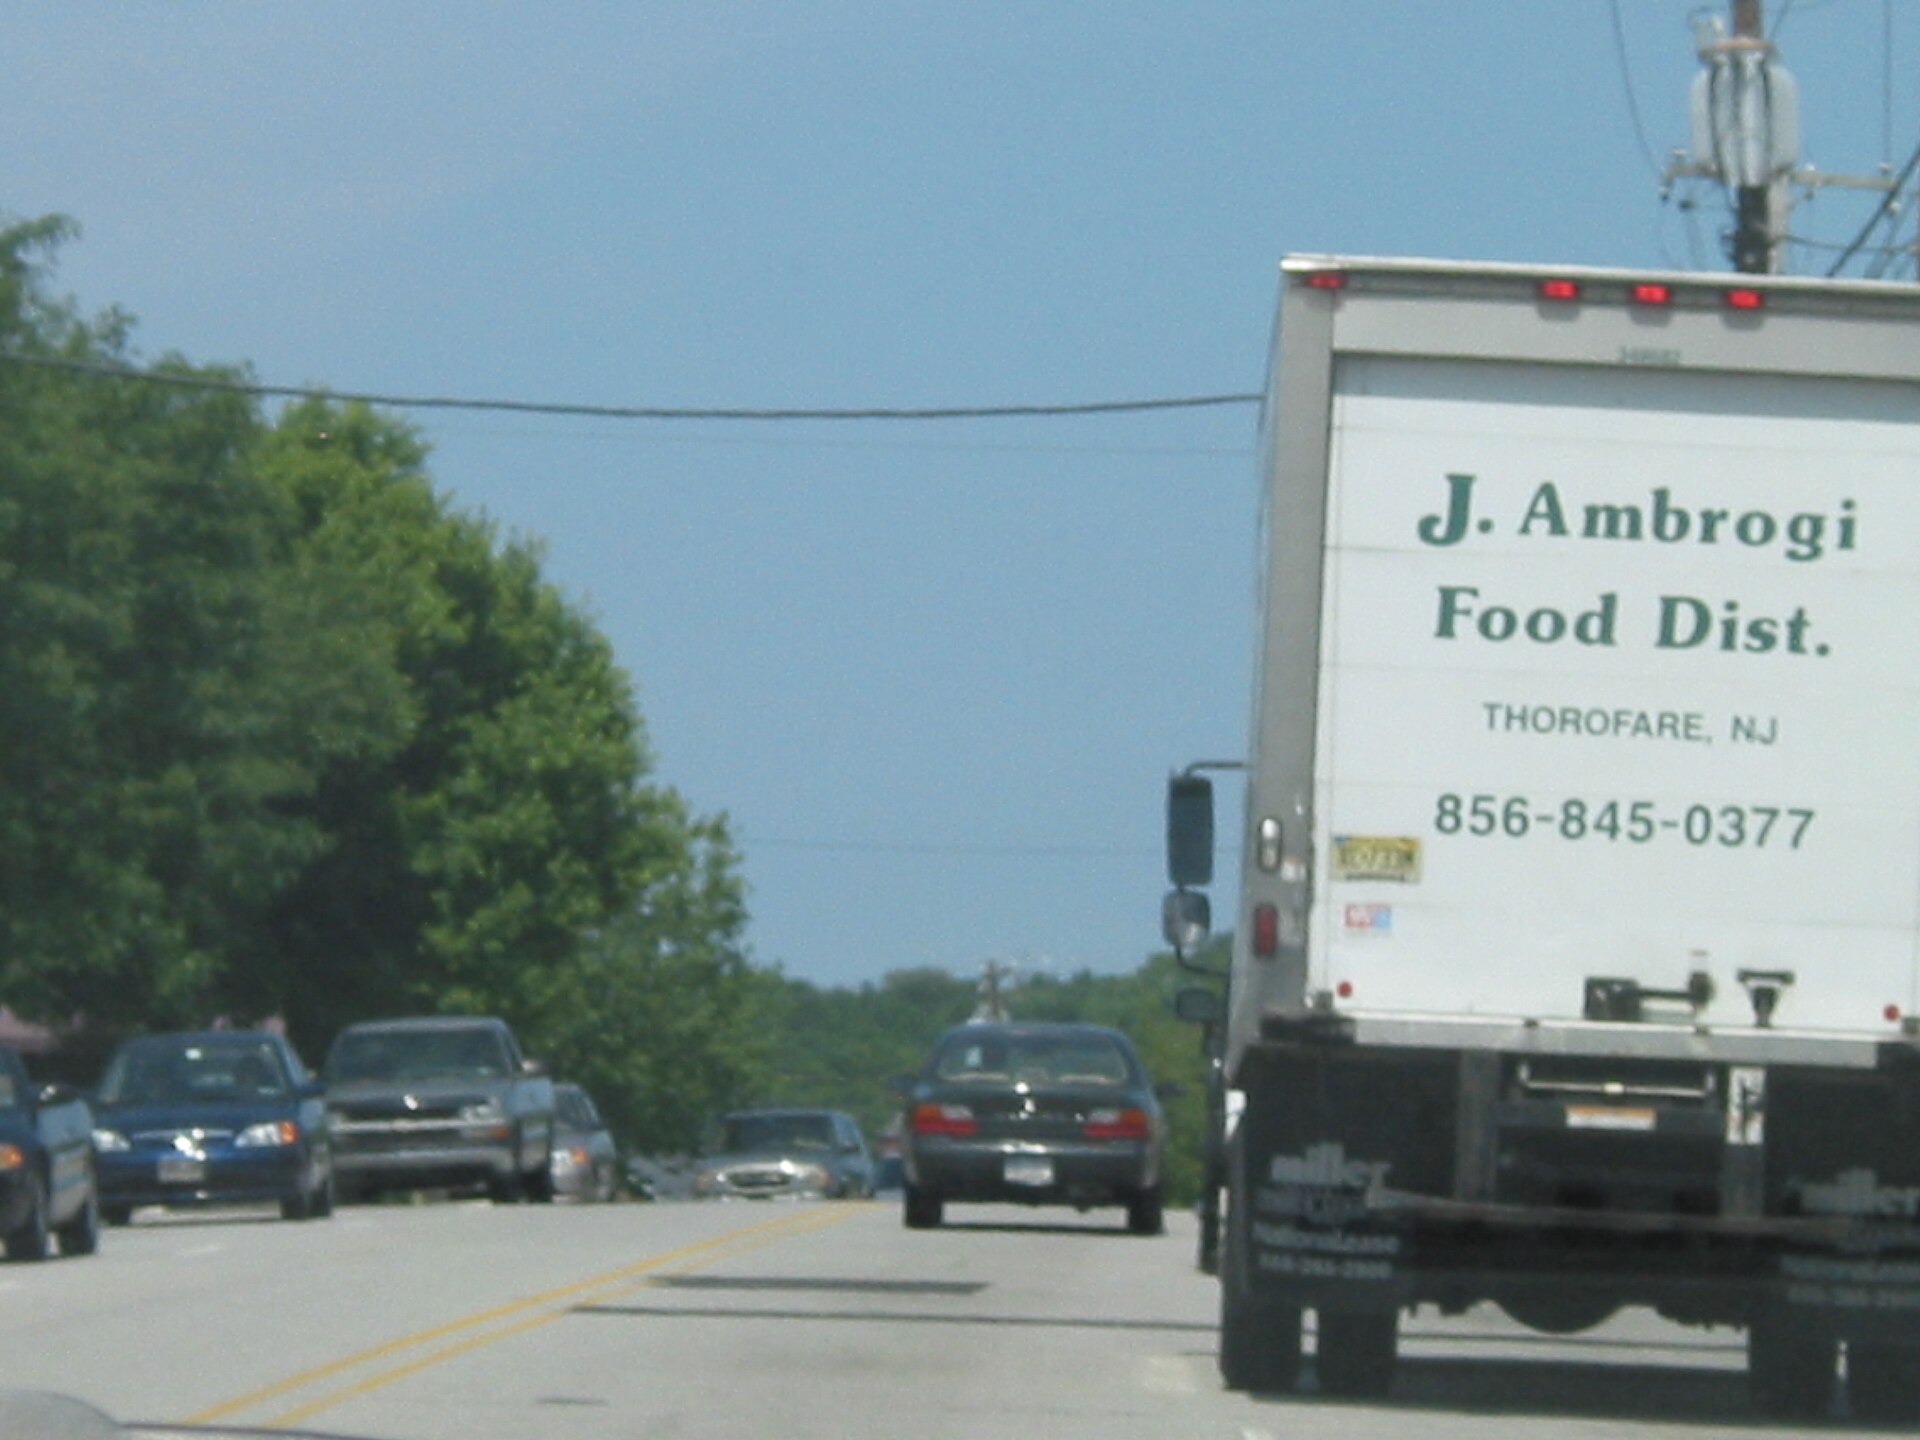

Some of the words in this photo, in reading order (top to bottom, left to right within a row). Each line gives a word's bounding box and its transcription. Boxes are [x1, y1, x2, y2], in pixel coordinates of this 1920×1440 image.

[1417, 473, 1495, 548] J.
[1517, 481, 1857, 563] Ambrogi
[1434, 586, 1618, 647] Food
[1655, 594, 1831, 657] Dist.
[1482, 702, 1711, 744] THOROFARE,
[1731, 715, 1778, 745] NJ
[1434, 793, 1816, 849] 856-845-0377
